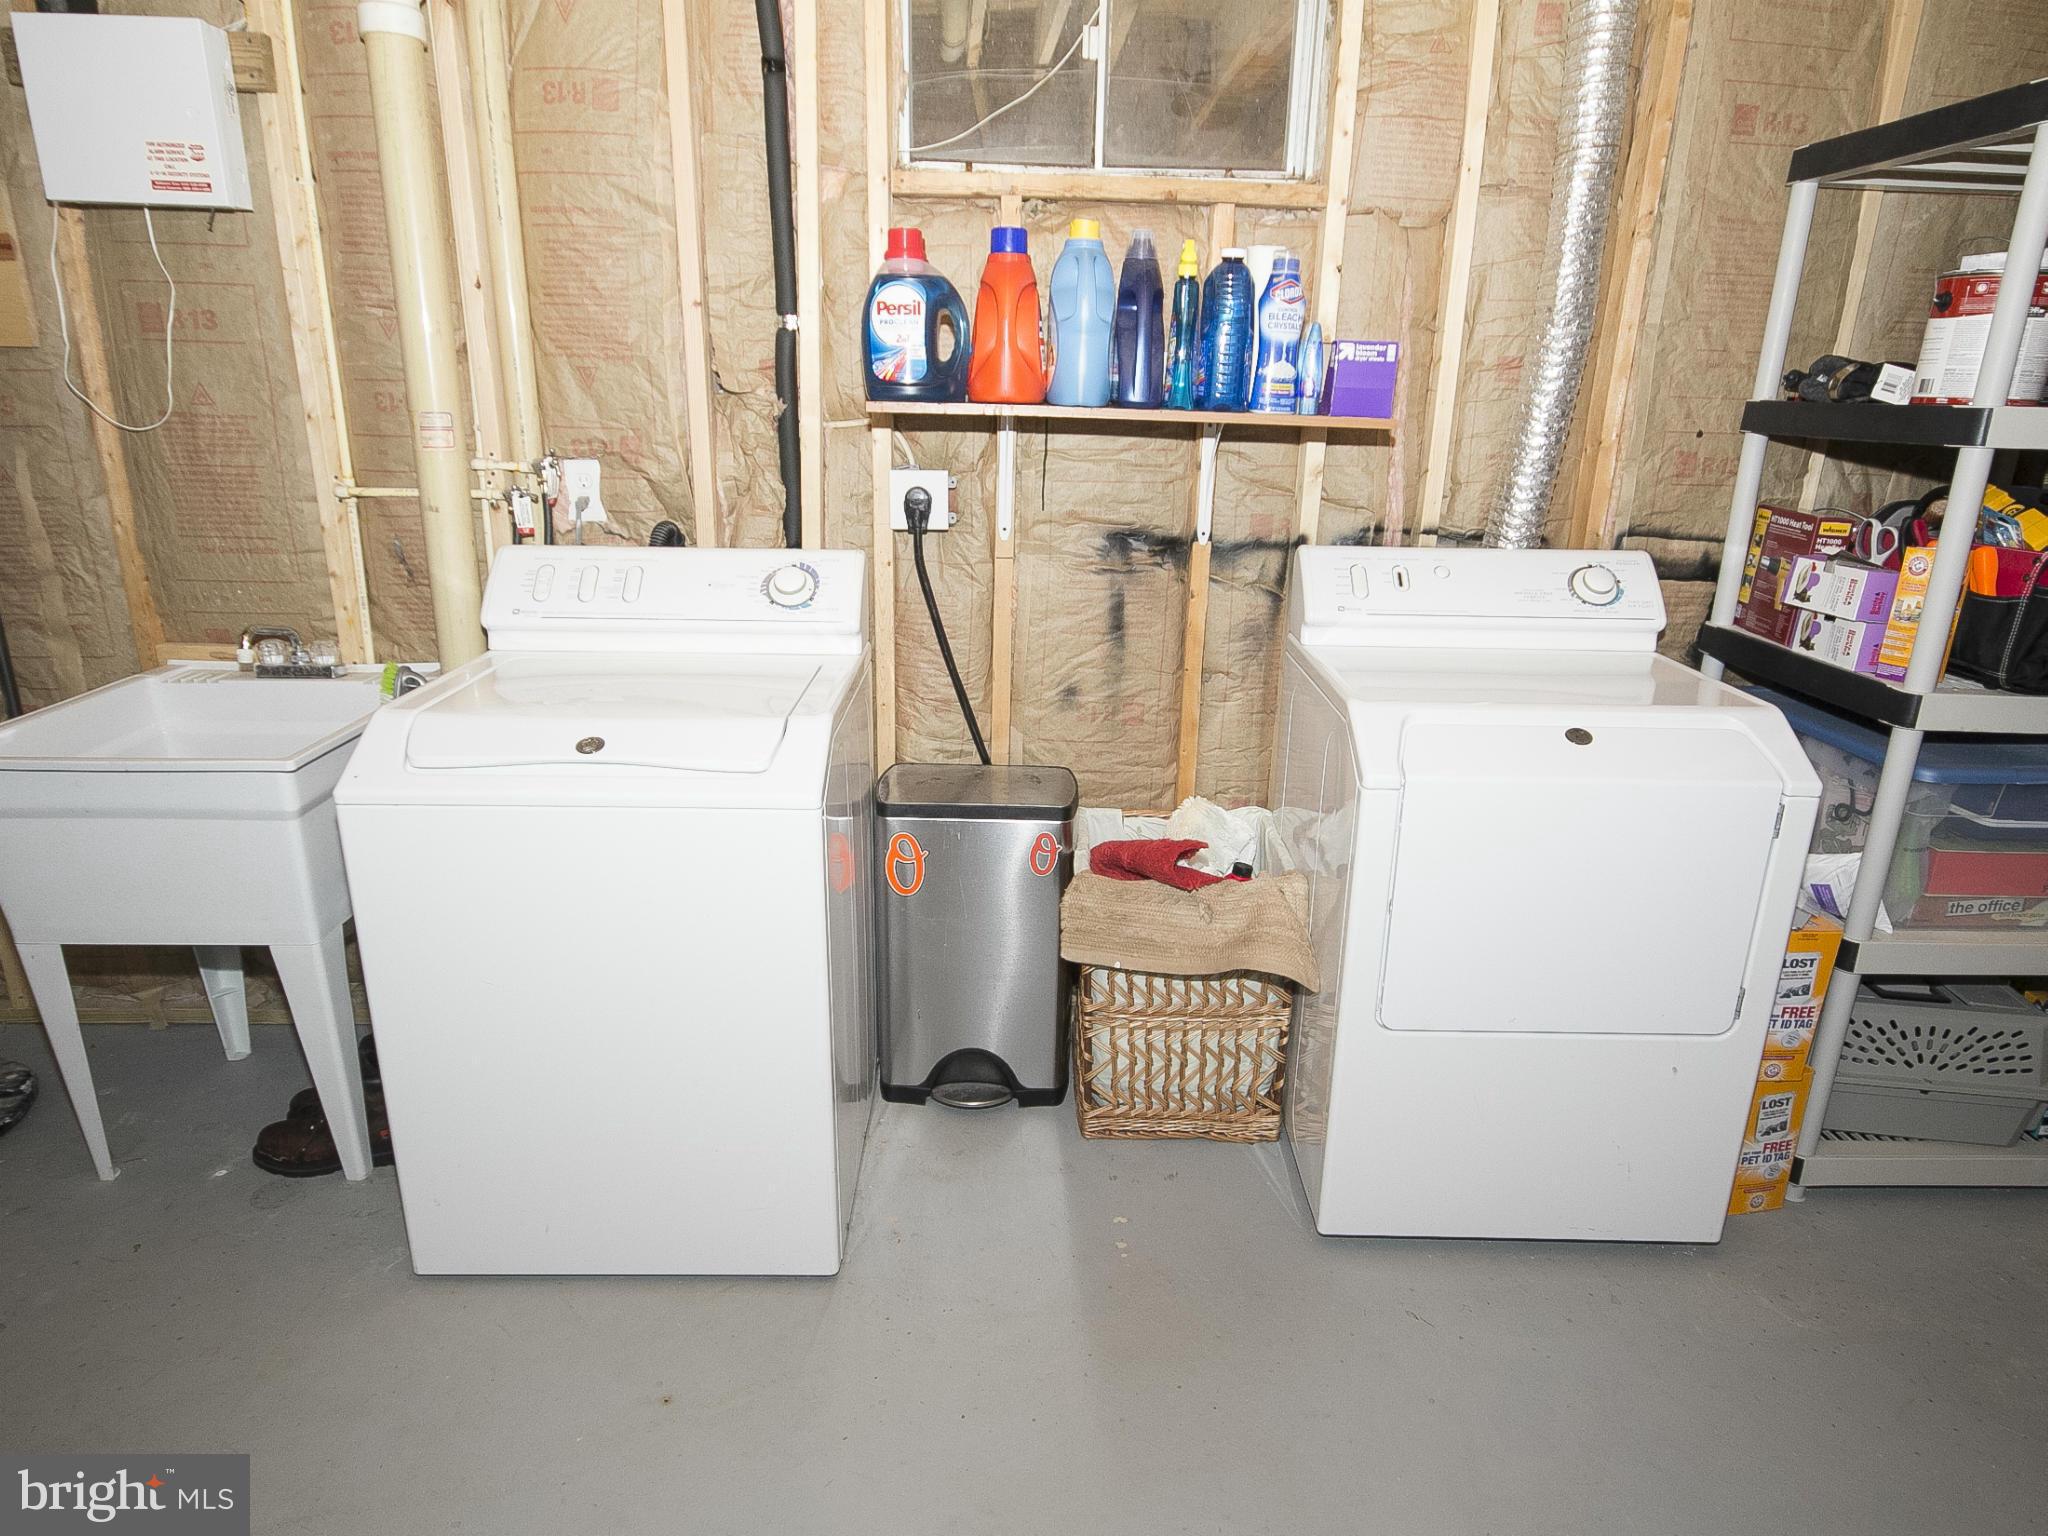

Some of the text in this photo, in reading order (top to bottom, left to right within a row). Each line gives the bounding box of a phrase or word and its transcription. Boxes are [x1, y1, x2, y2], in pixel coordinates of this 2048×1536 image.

[876, 299, 922, 316] Persil
[1356, 343, 1387, 352] lavender
[1029, 832, 1063, 877] O
[885, 832, 929, 896] O
[1949, 900, 2021, 914] the office
[1782, 958, 1818, 968] LOST
[1780, 1006, 1816, 1018] FREE
[1780, 1020, 1792, 1029] ID
[1794, 1020, 1812, 1028] TAG
[1762, 1096, 1792, 1110] LOST
[1762, 1140, 1793, 1154] FREE
[1741, 1152, 1791, 1165] PET ID TAG
